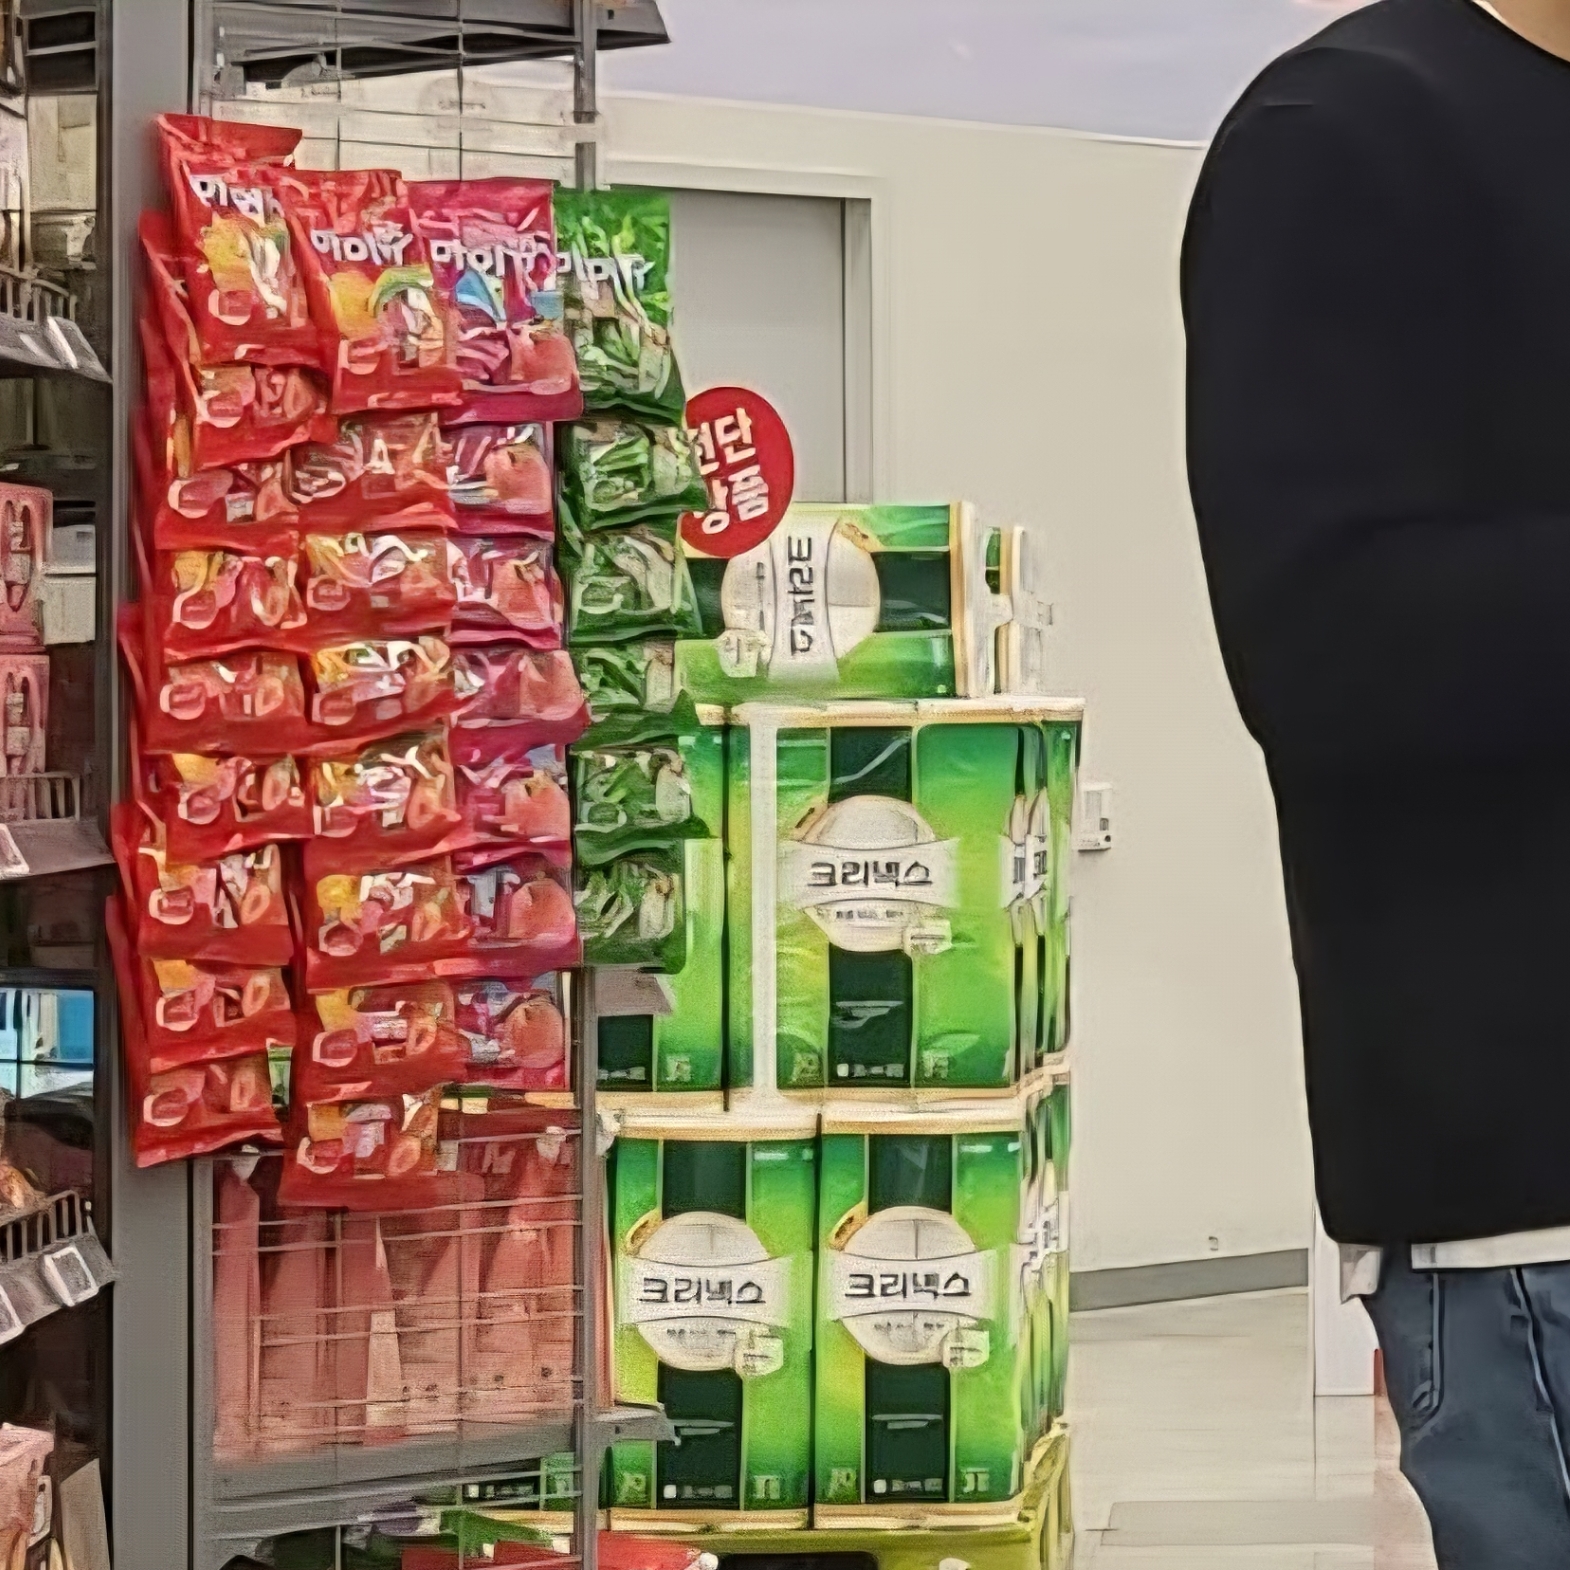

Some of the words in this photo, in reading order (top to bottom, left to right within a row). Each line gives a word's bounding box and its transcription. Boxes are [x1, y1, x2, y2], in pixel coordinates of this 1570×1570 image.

[807, 860, 933, 888] 크리넥스
[637, 1276, 766, 1305] 크리넥스
[844, 1271, 973, 1300] 크리넥스
